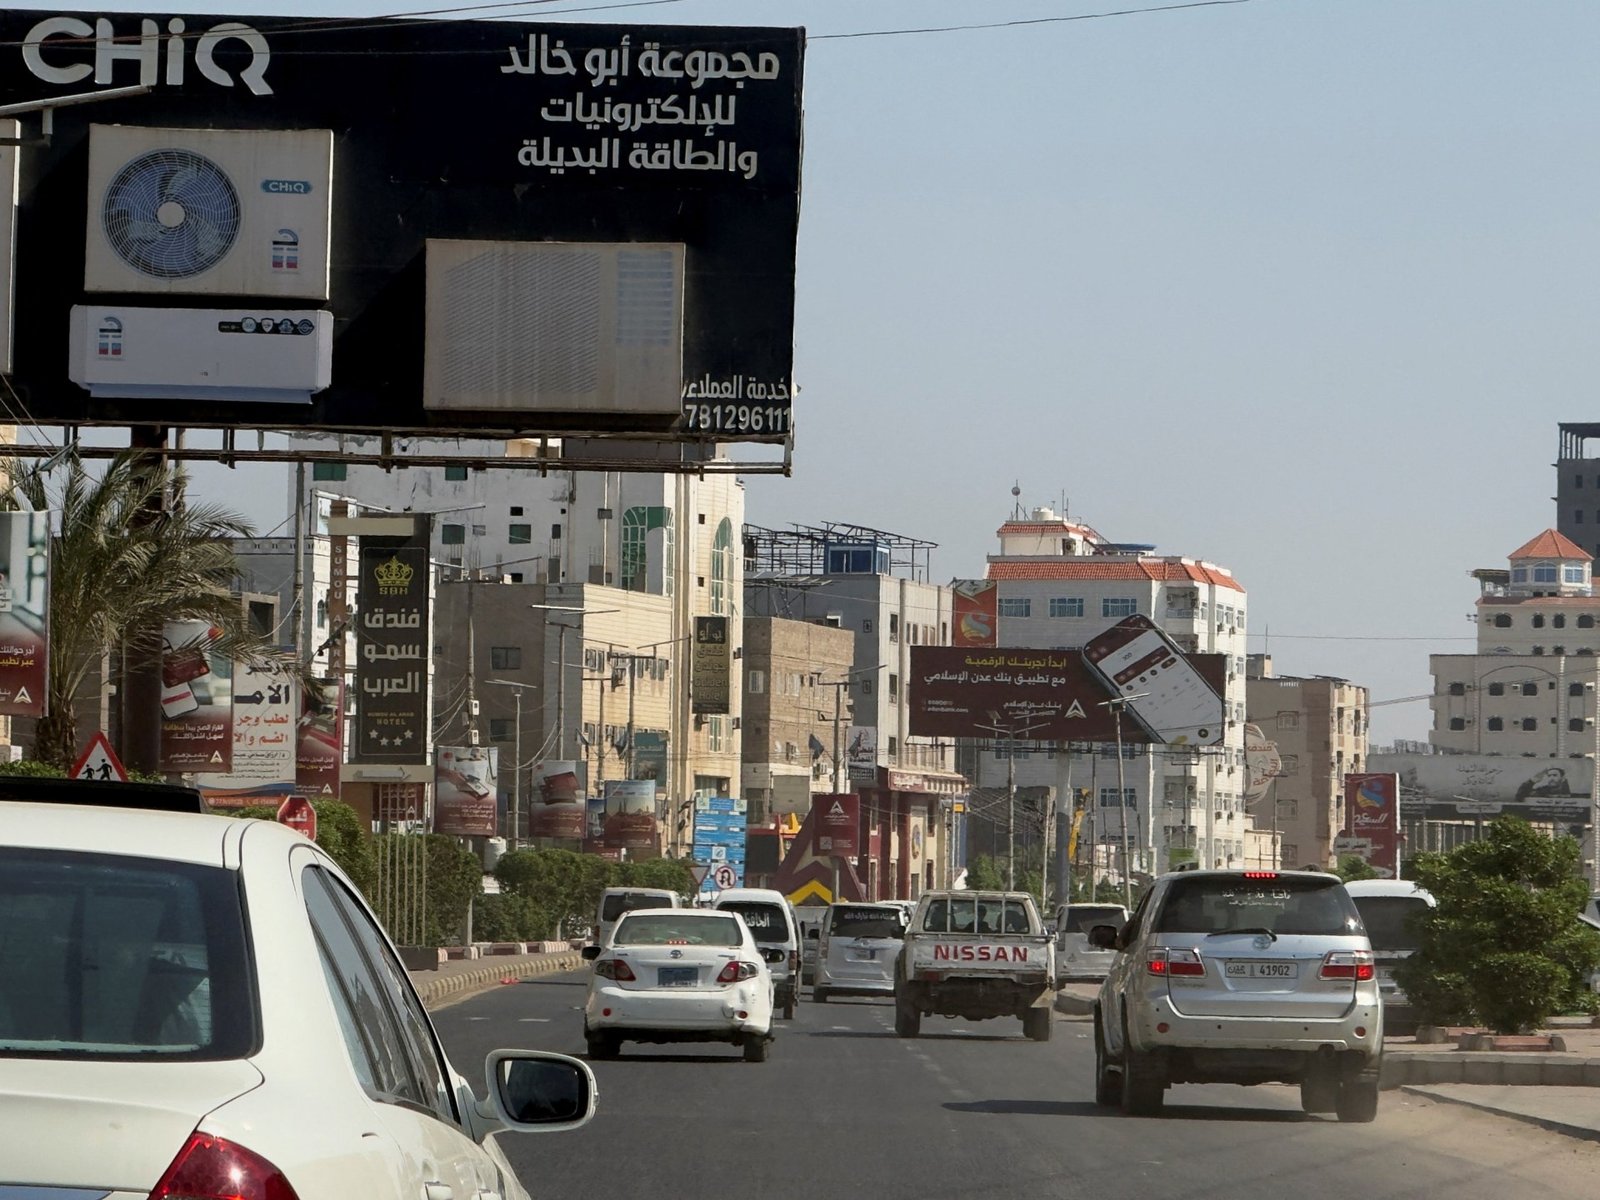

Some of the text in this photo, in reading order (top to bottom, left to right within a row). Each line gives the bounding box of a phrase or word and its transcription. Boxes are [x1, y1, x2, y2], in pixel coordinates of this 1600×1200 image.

[22, 17, 274, 96] CHiQ
[500, 33, 780, 89] مجموعة أبو خالد
[540, 92, 736, 137] للإلكترونيات
[518, 136, 758, 179] والطاقة البديلة
[746, 377, 790, 400] خدمة
[685, 404, 791, 432] 781296111
[364, 607, 420, 629] فندق
[0, 656, 20, 667] تطبي
[363, 644, 420, 664] سمو
[964, 655, 1005, 669] الرقمية
[363, 671, 420, 698] العرب
[923, 670, 1066, 687] مع تطبيق بنك عدن الإسلامي
[933, 944, 1028, 962] NISSAN
